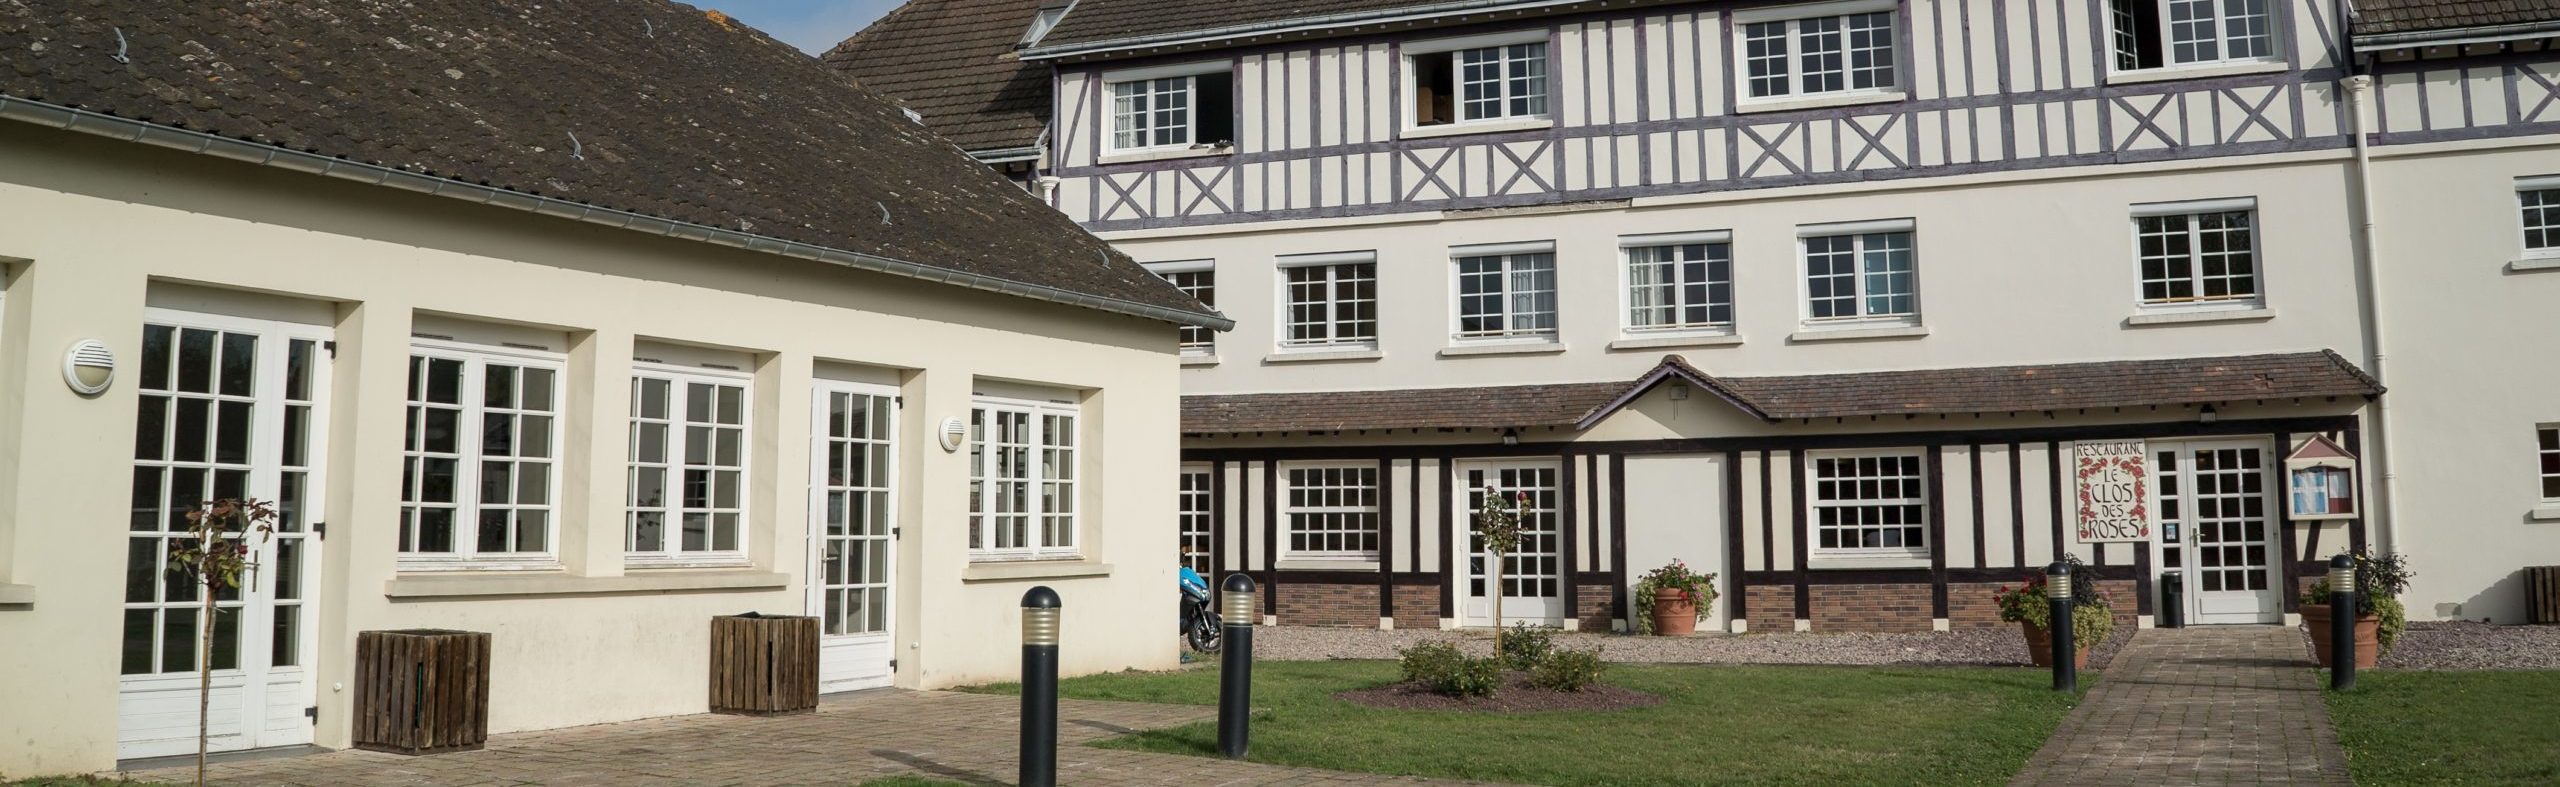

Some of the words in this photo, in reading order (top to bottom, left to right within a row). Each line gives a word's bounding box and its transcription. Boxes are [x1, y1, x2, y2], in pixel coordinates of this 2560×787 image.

[2104, 469, 2118, 482] LE
[2091, 483, 2133, 503] CLOS
[2102, 504, 2124, 517] DES
[2088, 519, 2139, 539] ROSES
